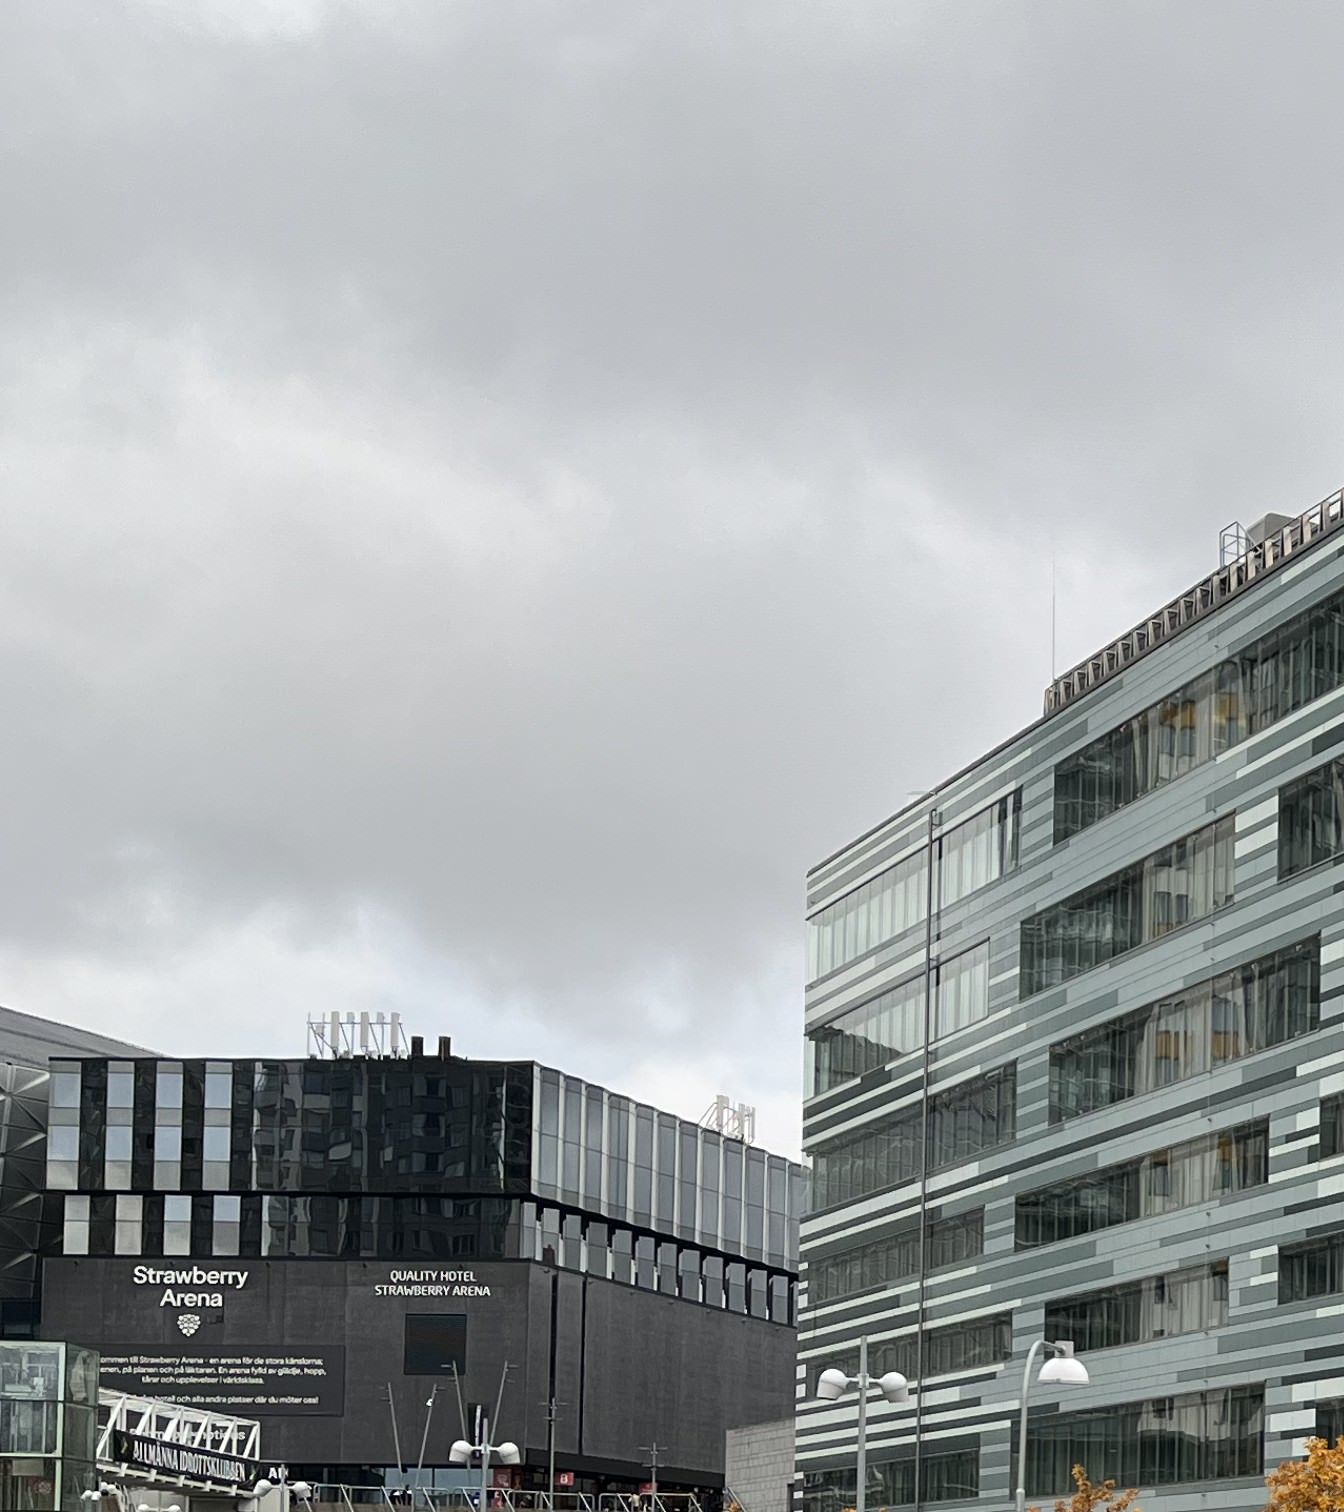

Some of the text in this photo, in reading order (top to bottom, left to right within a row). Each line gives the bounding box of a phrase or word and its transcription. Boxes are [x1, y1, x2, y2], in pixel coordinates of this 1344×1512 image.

[133, 1266, 248, 1288] Strawberry
[390, 1270, 477, 1283] QUALITY HOTEL
[160, 1289, 223, 1308] Arena
[374, 1285, 491, 1297] STRAWBERRY ARENA
[132, 1440, 246, 1483] ALLMÄNNA IDROTTSKLUBBEN
